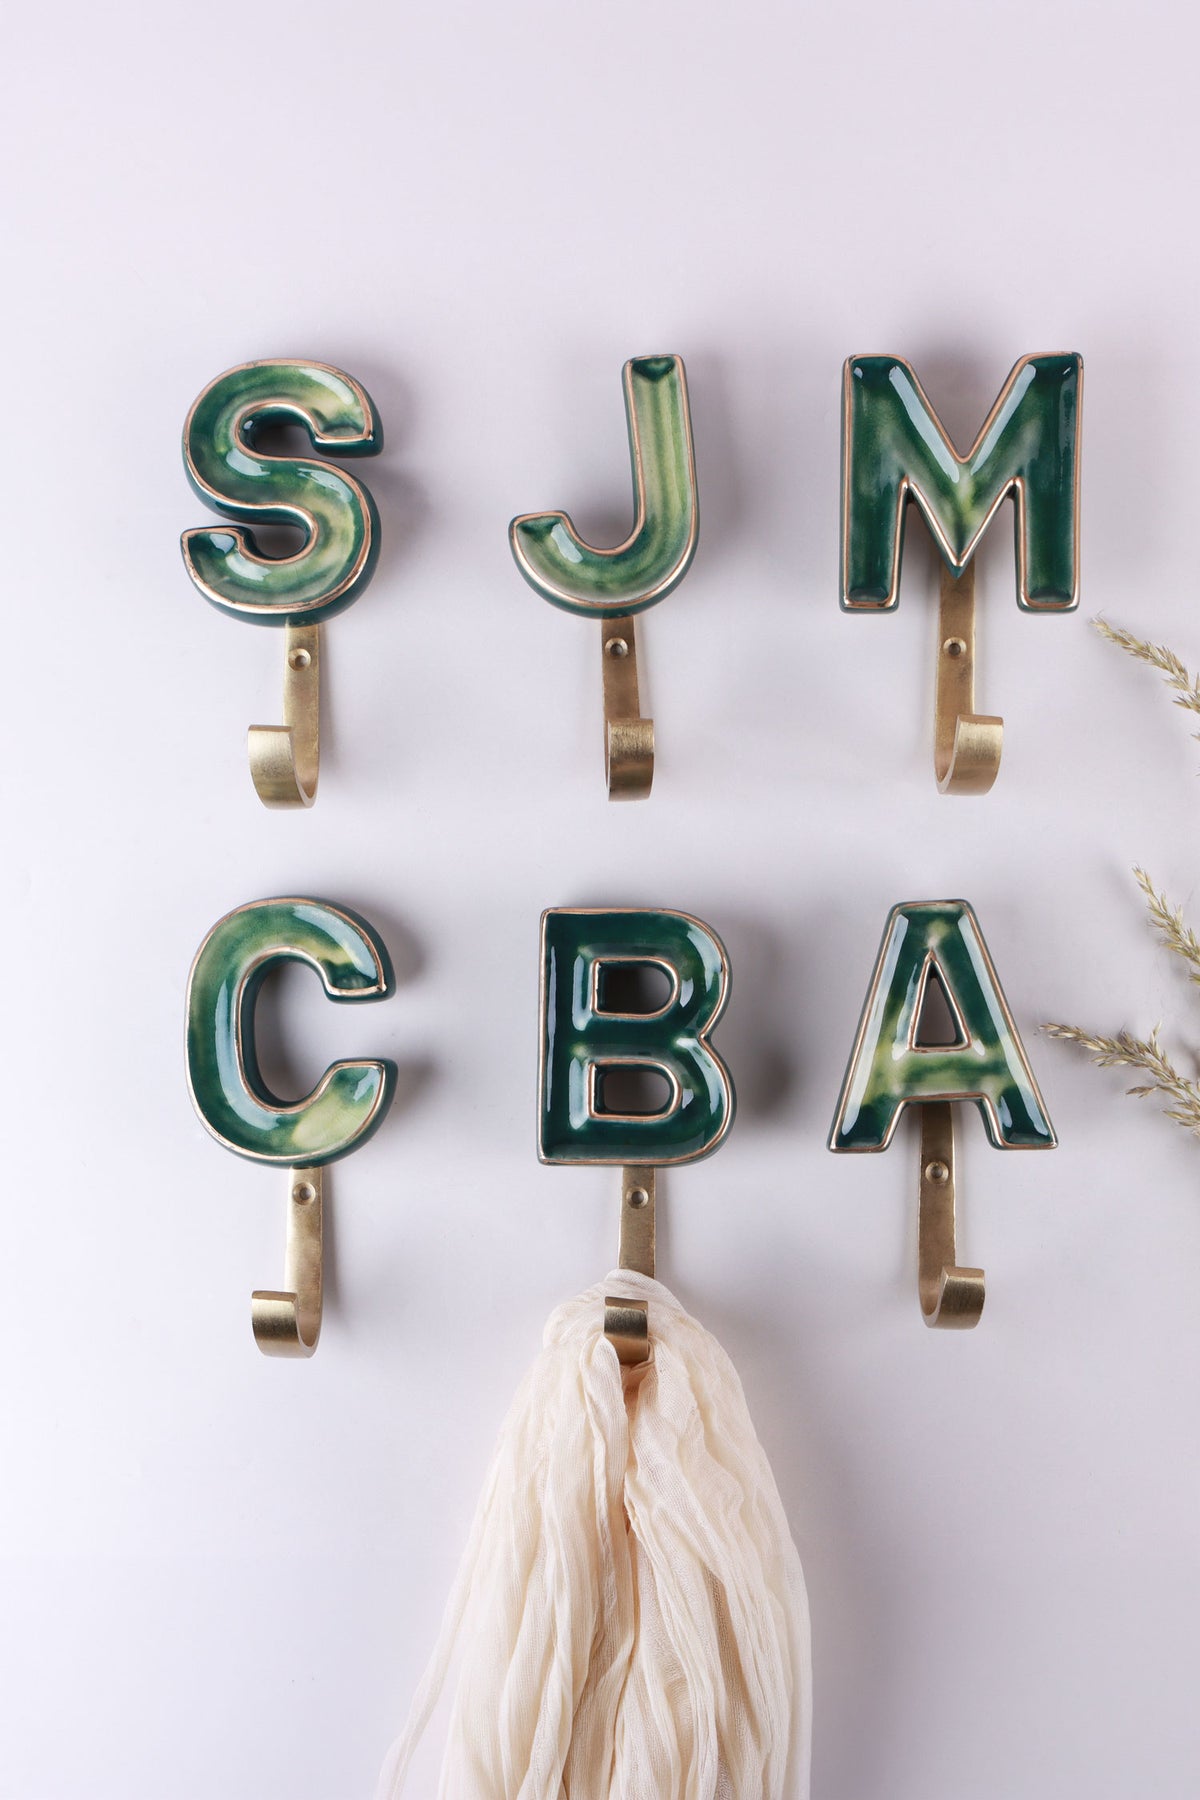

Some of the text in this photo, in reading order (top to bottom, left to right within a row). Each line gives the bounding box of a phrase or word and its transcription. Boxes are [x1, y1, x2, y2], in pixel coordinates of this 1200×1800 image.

[181, 358, 384, 627] S
[508, 353, 700, 619] J
[840, 351, 1083, 613] M
[184, 895, 398, 1169] C
[537, 907, 736, 1167] B
[827, 899, 1058, 1152] A
